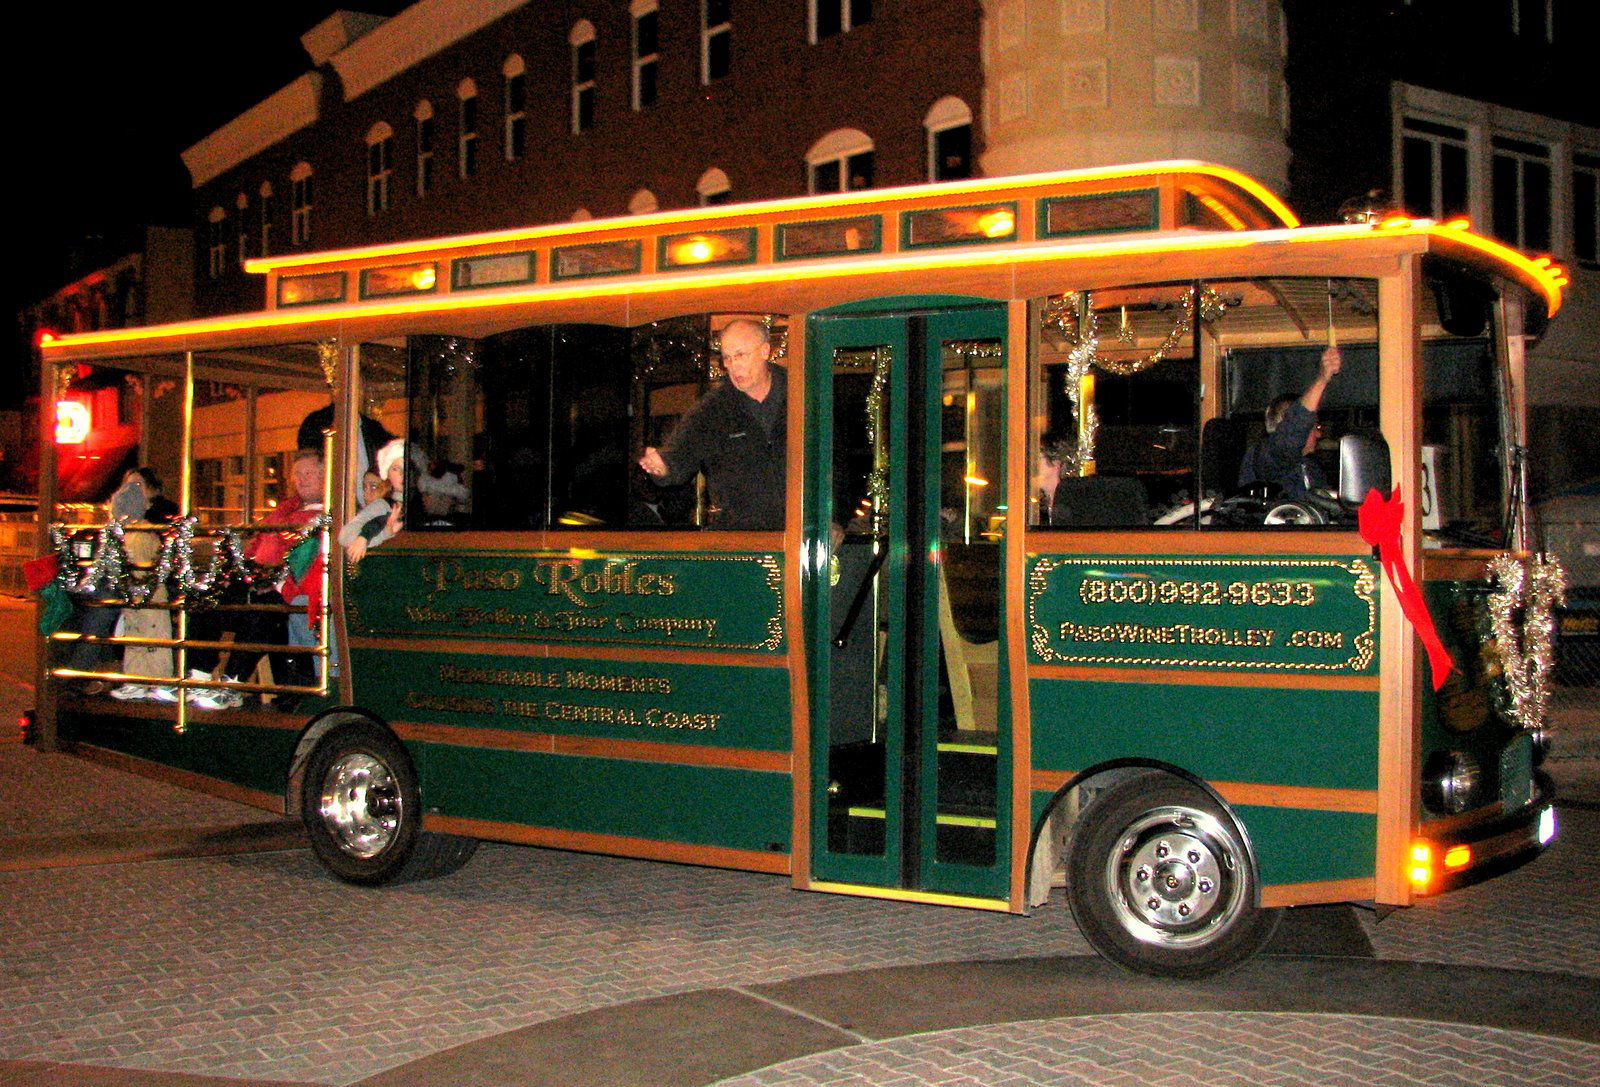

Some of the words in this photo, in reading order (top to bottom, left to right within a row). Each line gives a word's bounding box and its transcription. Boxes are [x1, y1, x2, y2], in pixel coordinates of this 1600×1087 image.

[421, 558, 522, 602] Paso
[533, 560, 675, 609] Robles
[1079, 579, 1316, 607] (800)992-9633
[615, 611, 718, 638] Company
[565, 670, 672, 695] MOMENTS
[544, 700, 643, 726] CENTRAL
[645, 706, 721, 731] COAST
